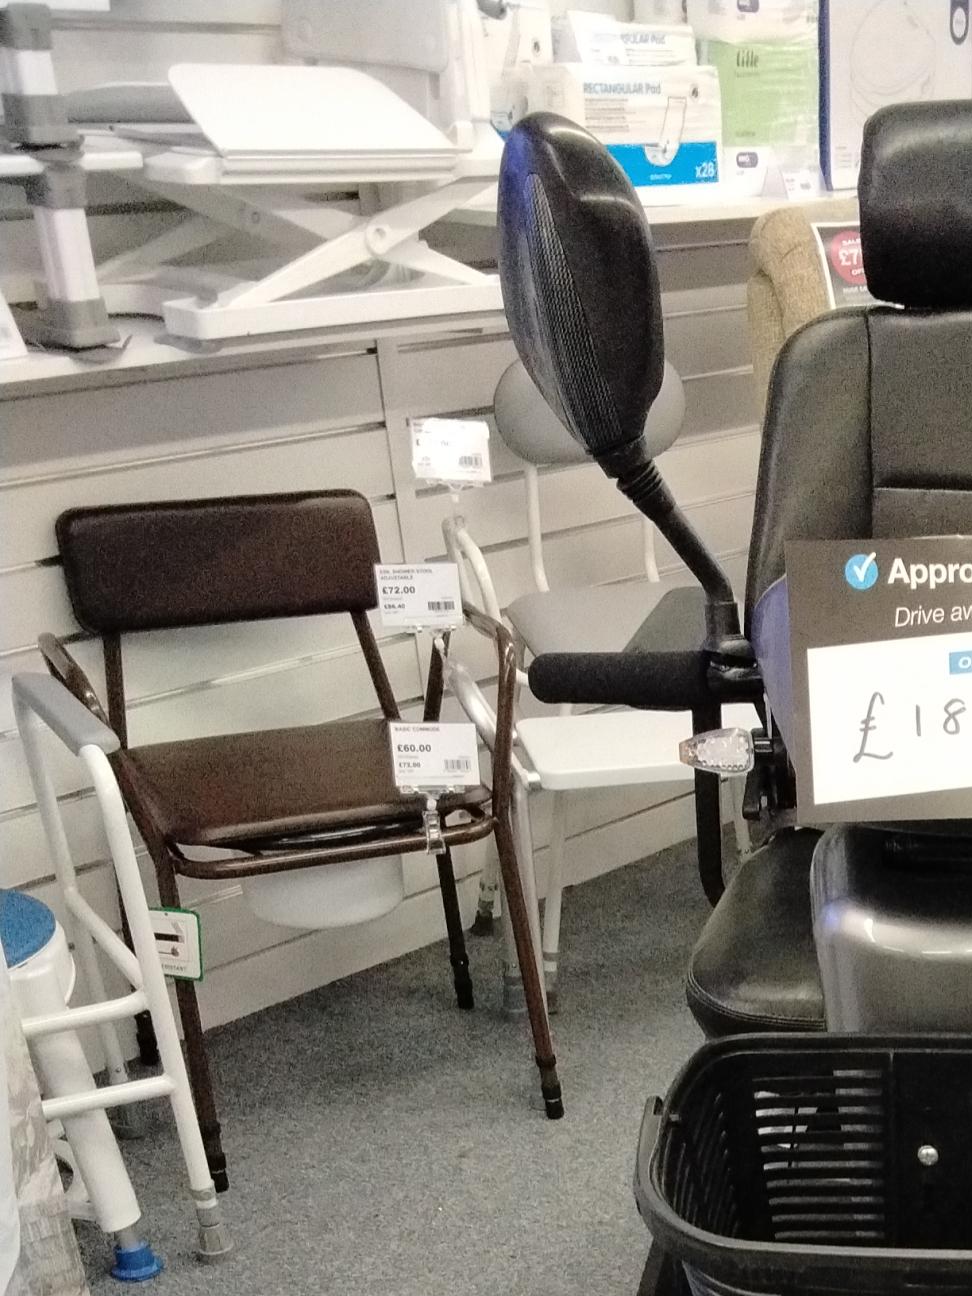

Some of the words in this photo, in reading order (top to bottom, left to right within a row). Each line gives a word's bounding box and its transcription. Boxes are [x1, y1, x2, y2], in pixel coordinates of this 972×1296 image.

[583, 83, 643, 95] RECTANGULAR
[645, 83, 661, 95] Pad
[695, 163, 715, 178] x28
[838, 248, 863, 266] £7
[382, 586, 416, 595] £72.00
[894, 605, 945, 628] Drive
[397, 744, 432, 753] £60.00
